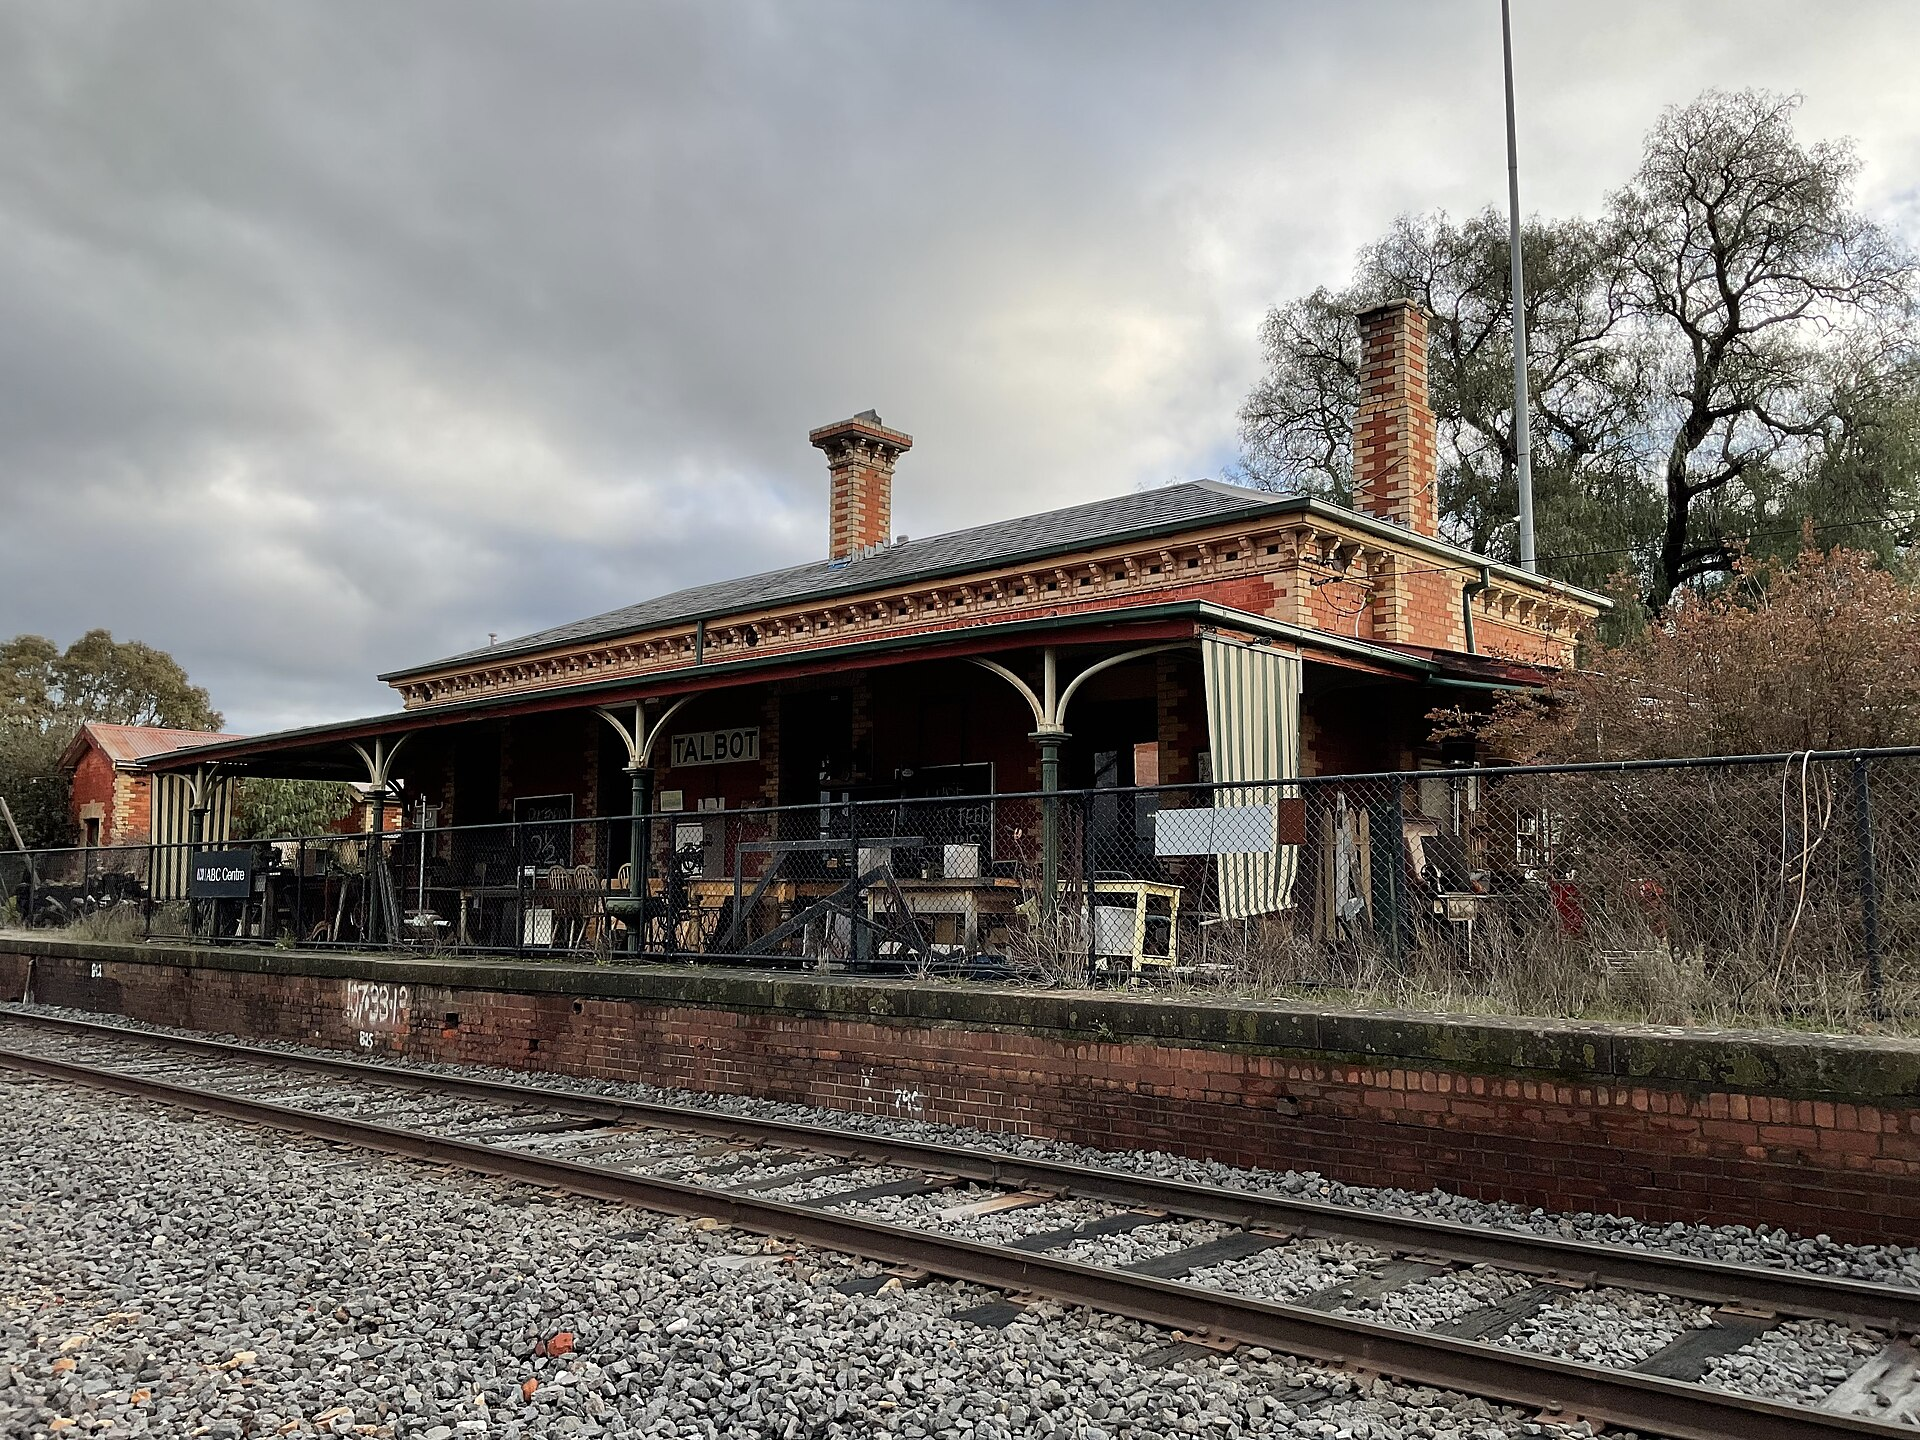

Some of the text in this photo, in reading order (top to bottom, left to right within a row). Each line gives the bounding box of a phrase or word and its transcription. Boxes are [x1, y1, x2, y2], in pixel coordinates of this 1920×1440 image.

[673, 730, 758, 764] TALBOT
[206, 867, 221, 881] ABC
[222, 866, 245, 881] Centre
